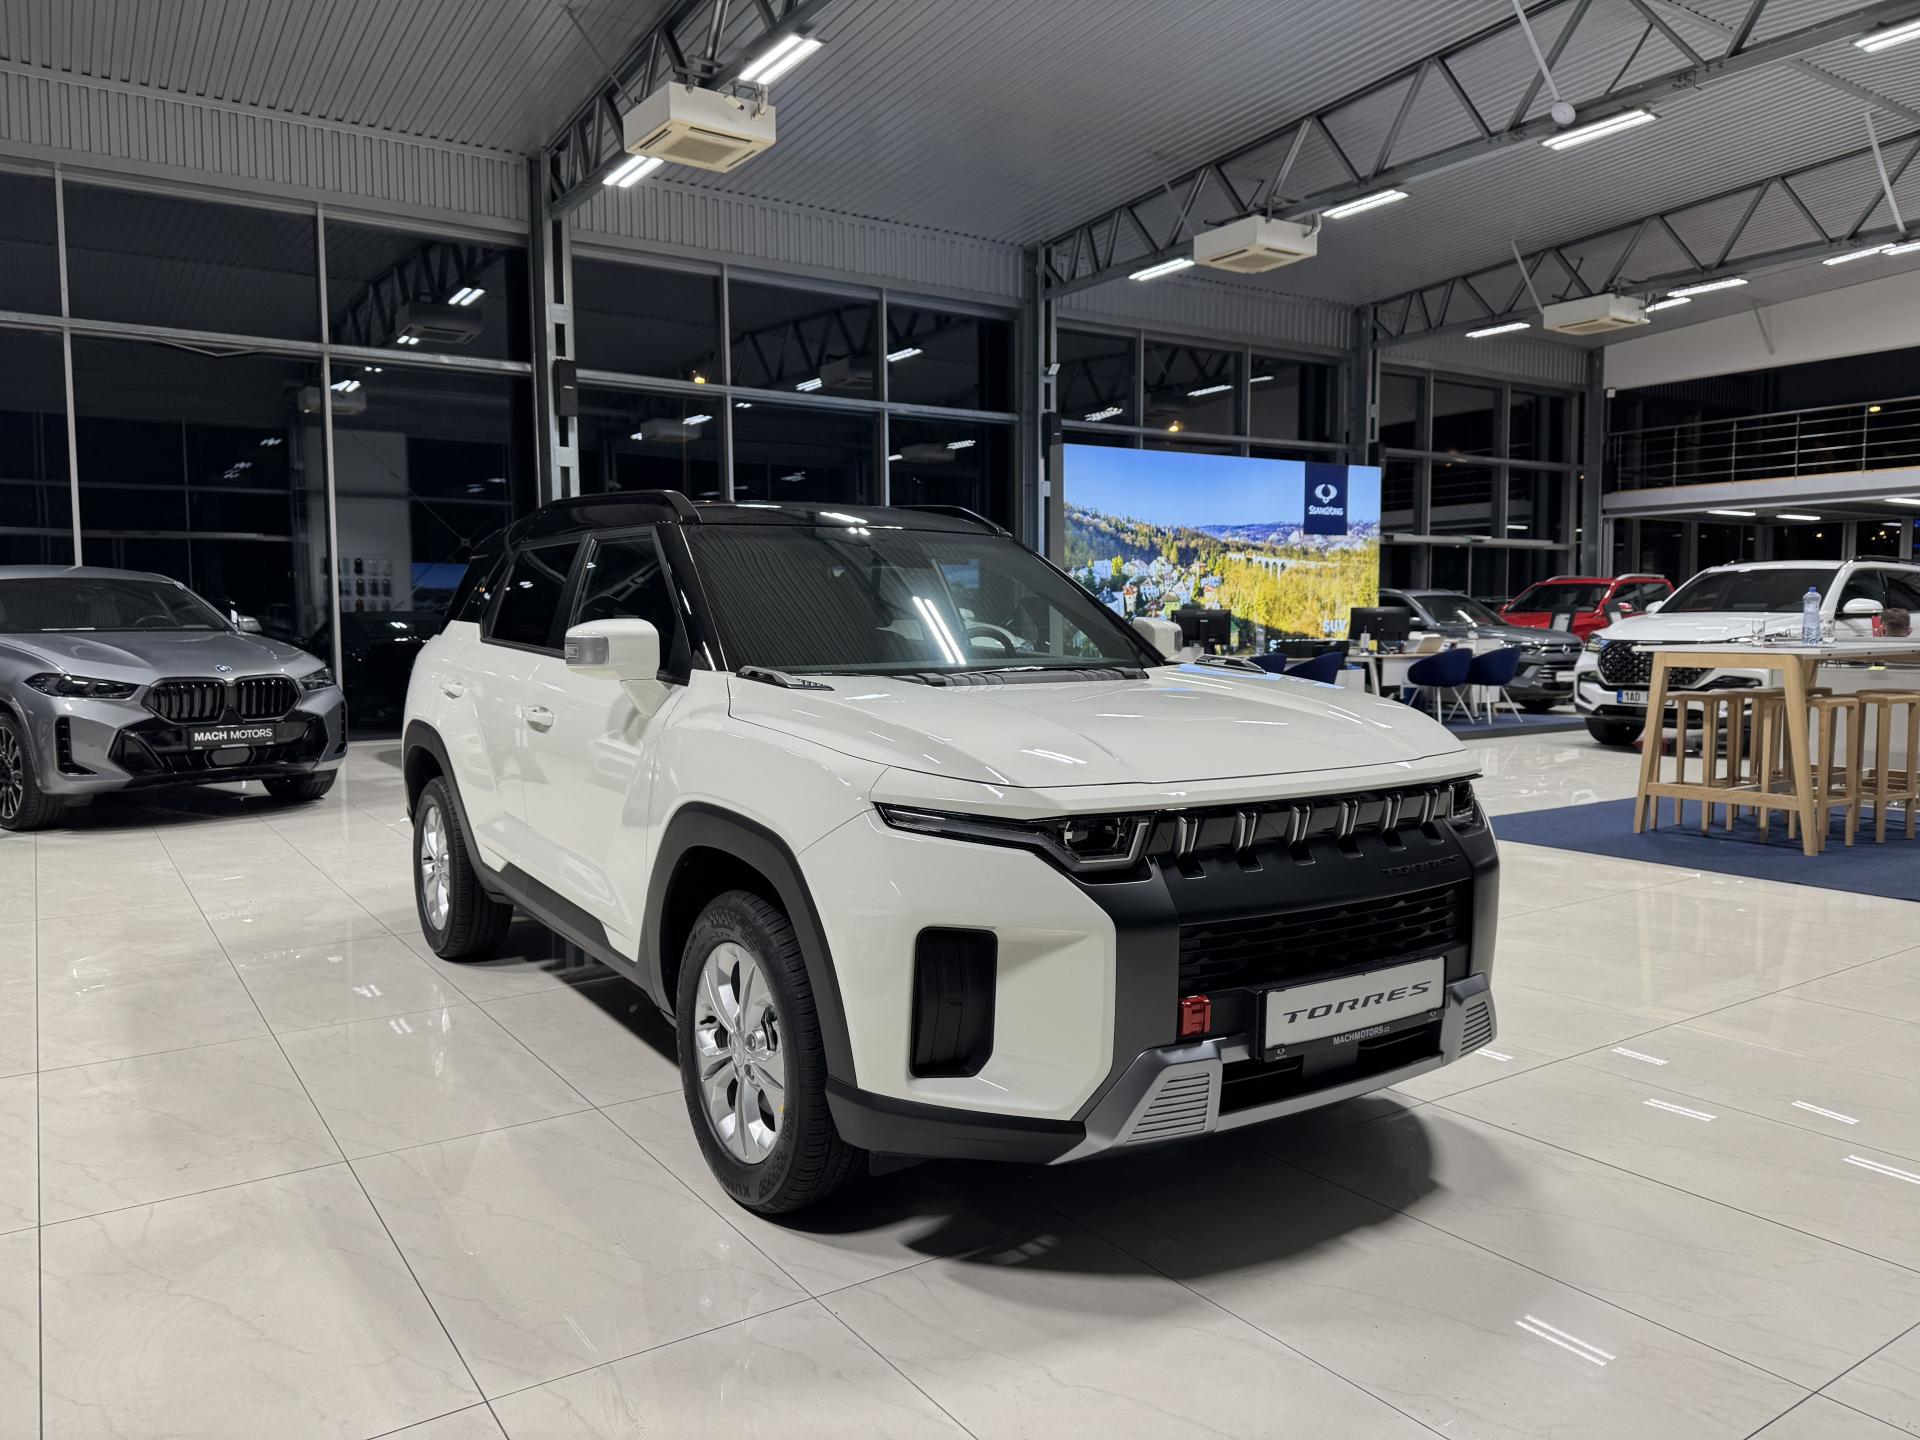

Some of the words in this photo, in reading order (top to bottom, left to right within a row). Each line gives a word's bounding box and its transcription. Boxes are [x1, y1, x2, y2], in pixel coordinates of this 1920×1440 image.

[194, 731, 227, 742] MACH
[230, 728, 273, 739] MOTORS
[1282, 980, 1432, 1024] TORRES
